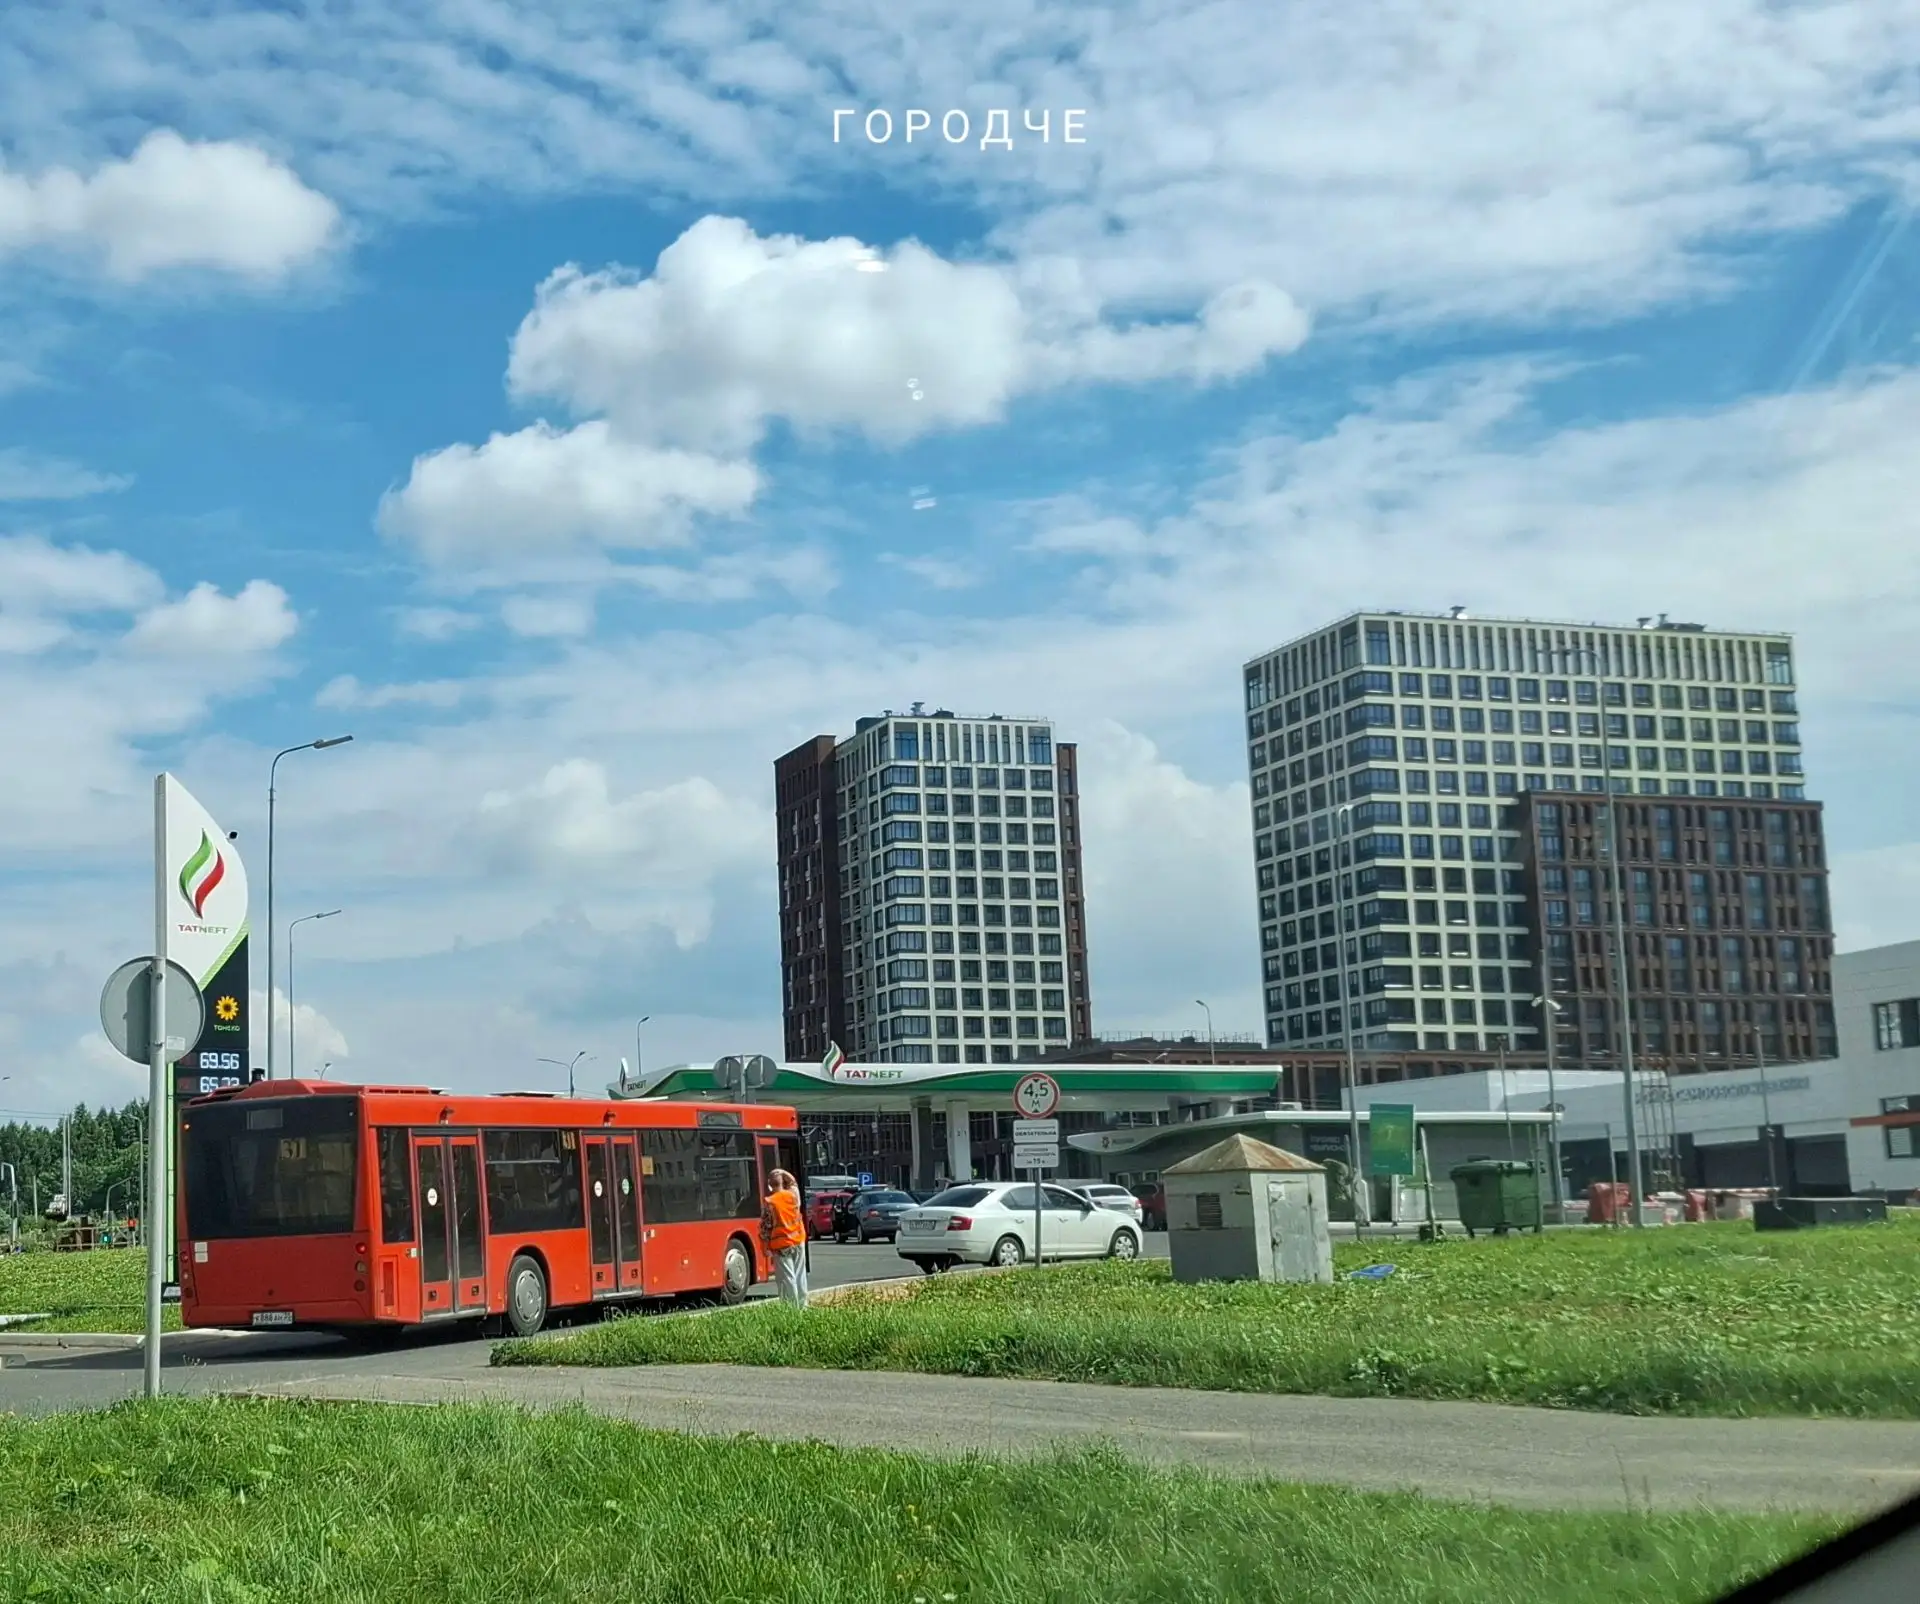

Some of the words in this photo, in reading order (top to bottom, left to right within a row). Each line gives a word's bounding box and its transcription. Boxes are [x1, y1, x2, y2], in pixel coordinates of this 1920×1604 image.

[177, 924, 229, 935] TATNEFT
[199, 1052, 240, 1070] 69.56
[844, 1069, 904, 1079] TATNEFT
[1023, 1082, 1049, 1098] 4,5
